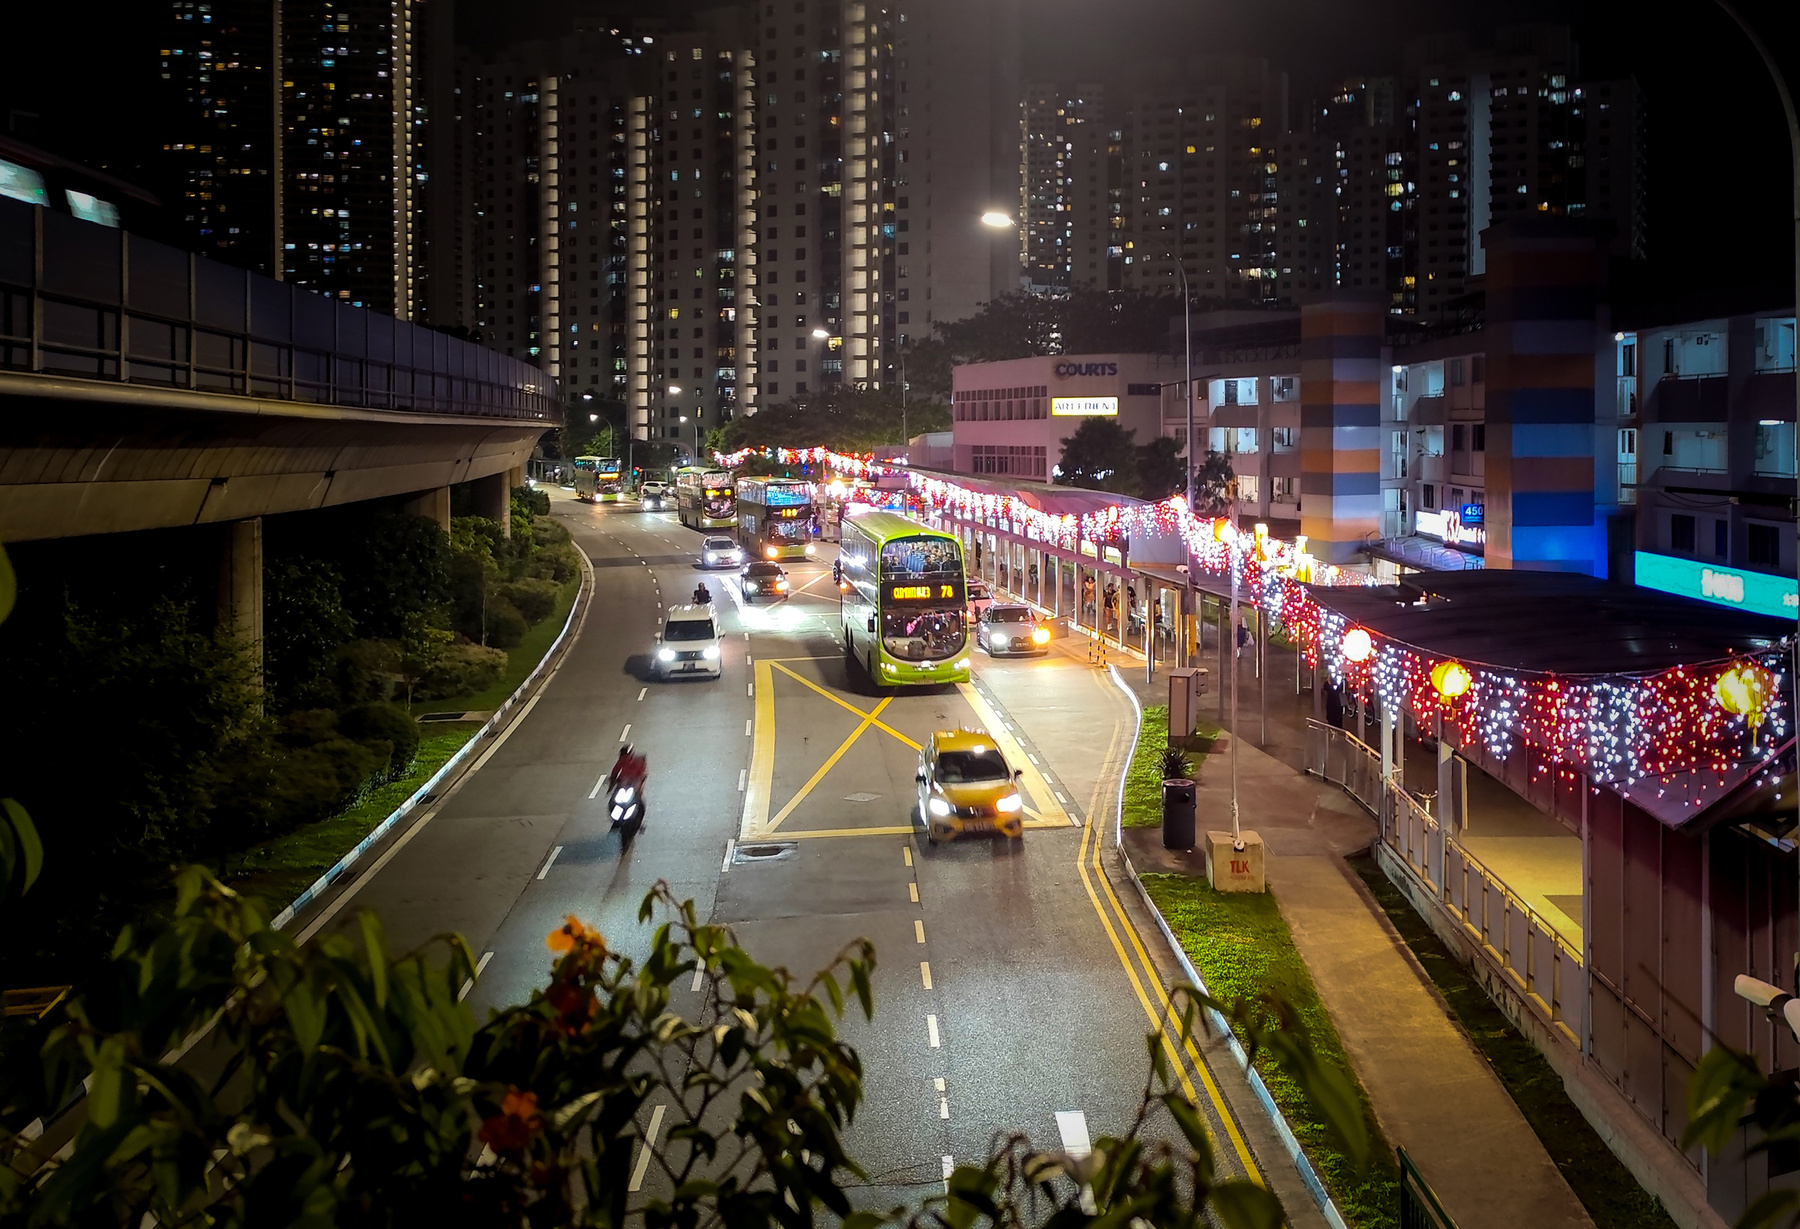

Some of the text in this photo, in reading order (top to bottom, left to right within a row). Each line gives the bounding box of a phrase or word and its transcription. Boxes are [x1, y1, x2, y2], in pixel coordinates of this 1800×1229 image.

[1055, 362, 1118, 377] COURTS
[1464, 506, 1484, 516] 450
[940, 585, 954, 598] 78
[1229, 860, 1250, 874] TLK
